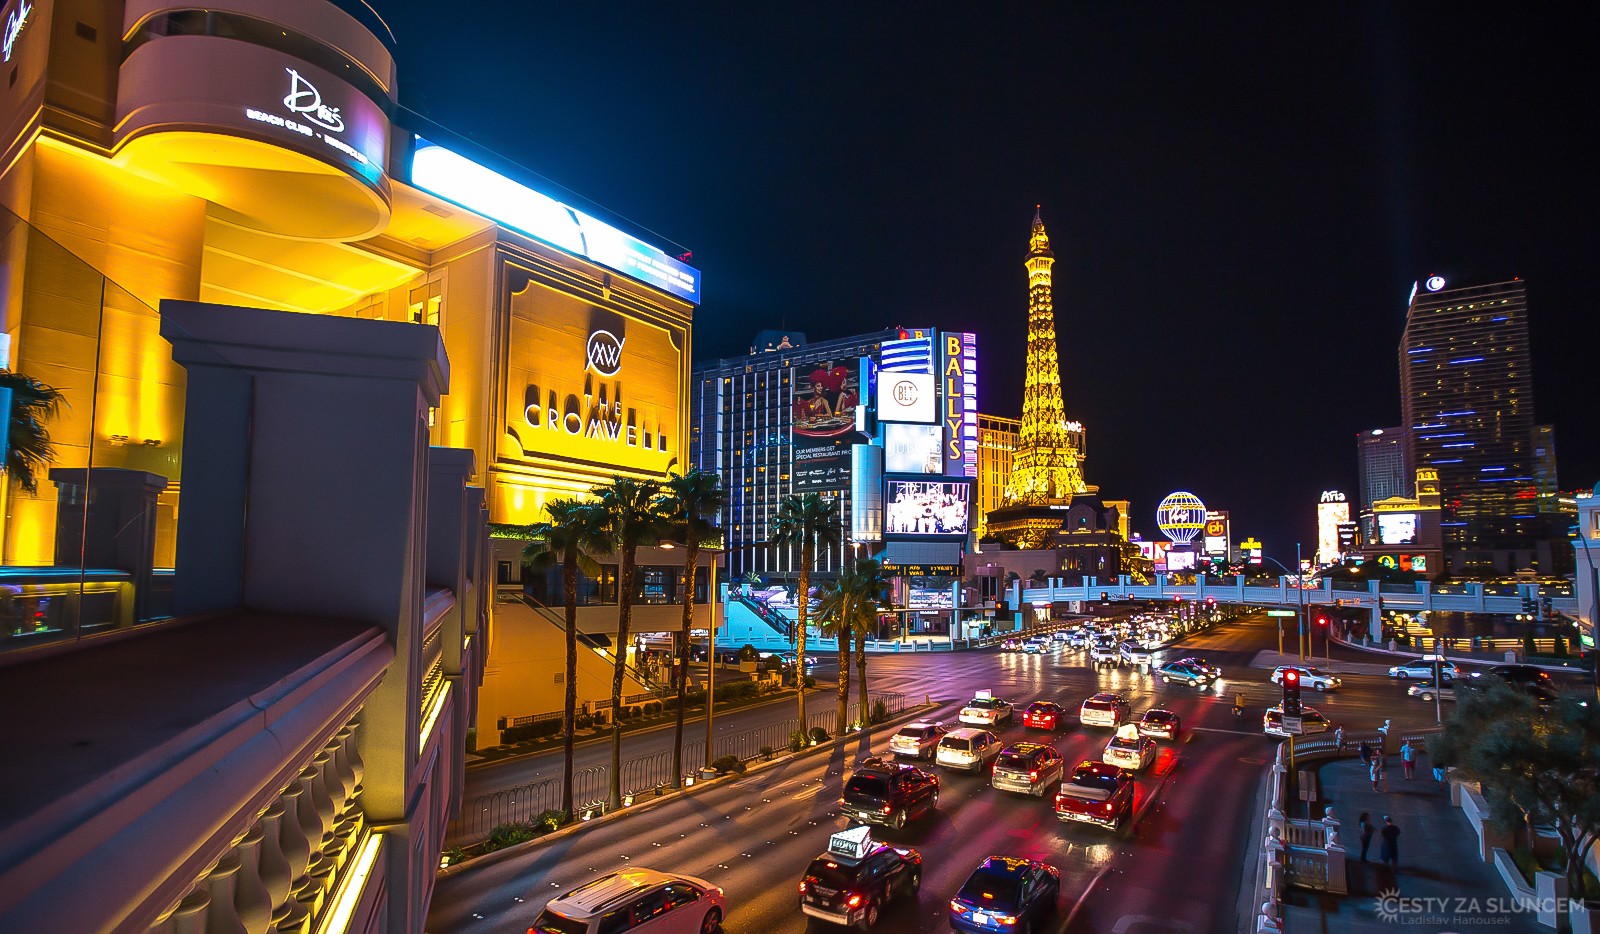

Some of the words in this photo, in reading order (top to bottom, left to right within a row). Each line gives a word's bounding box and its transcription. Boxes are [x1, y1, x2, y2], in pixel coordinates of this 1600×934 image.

[246, 109, 284, 126] BEACH
[285, 120, 313, 136] CLUB
[584, 394, 622, 416] THE
[524, 403, 667, 453] CROMWELL
[1320, 490, 1346, 503] Aria
